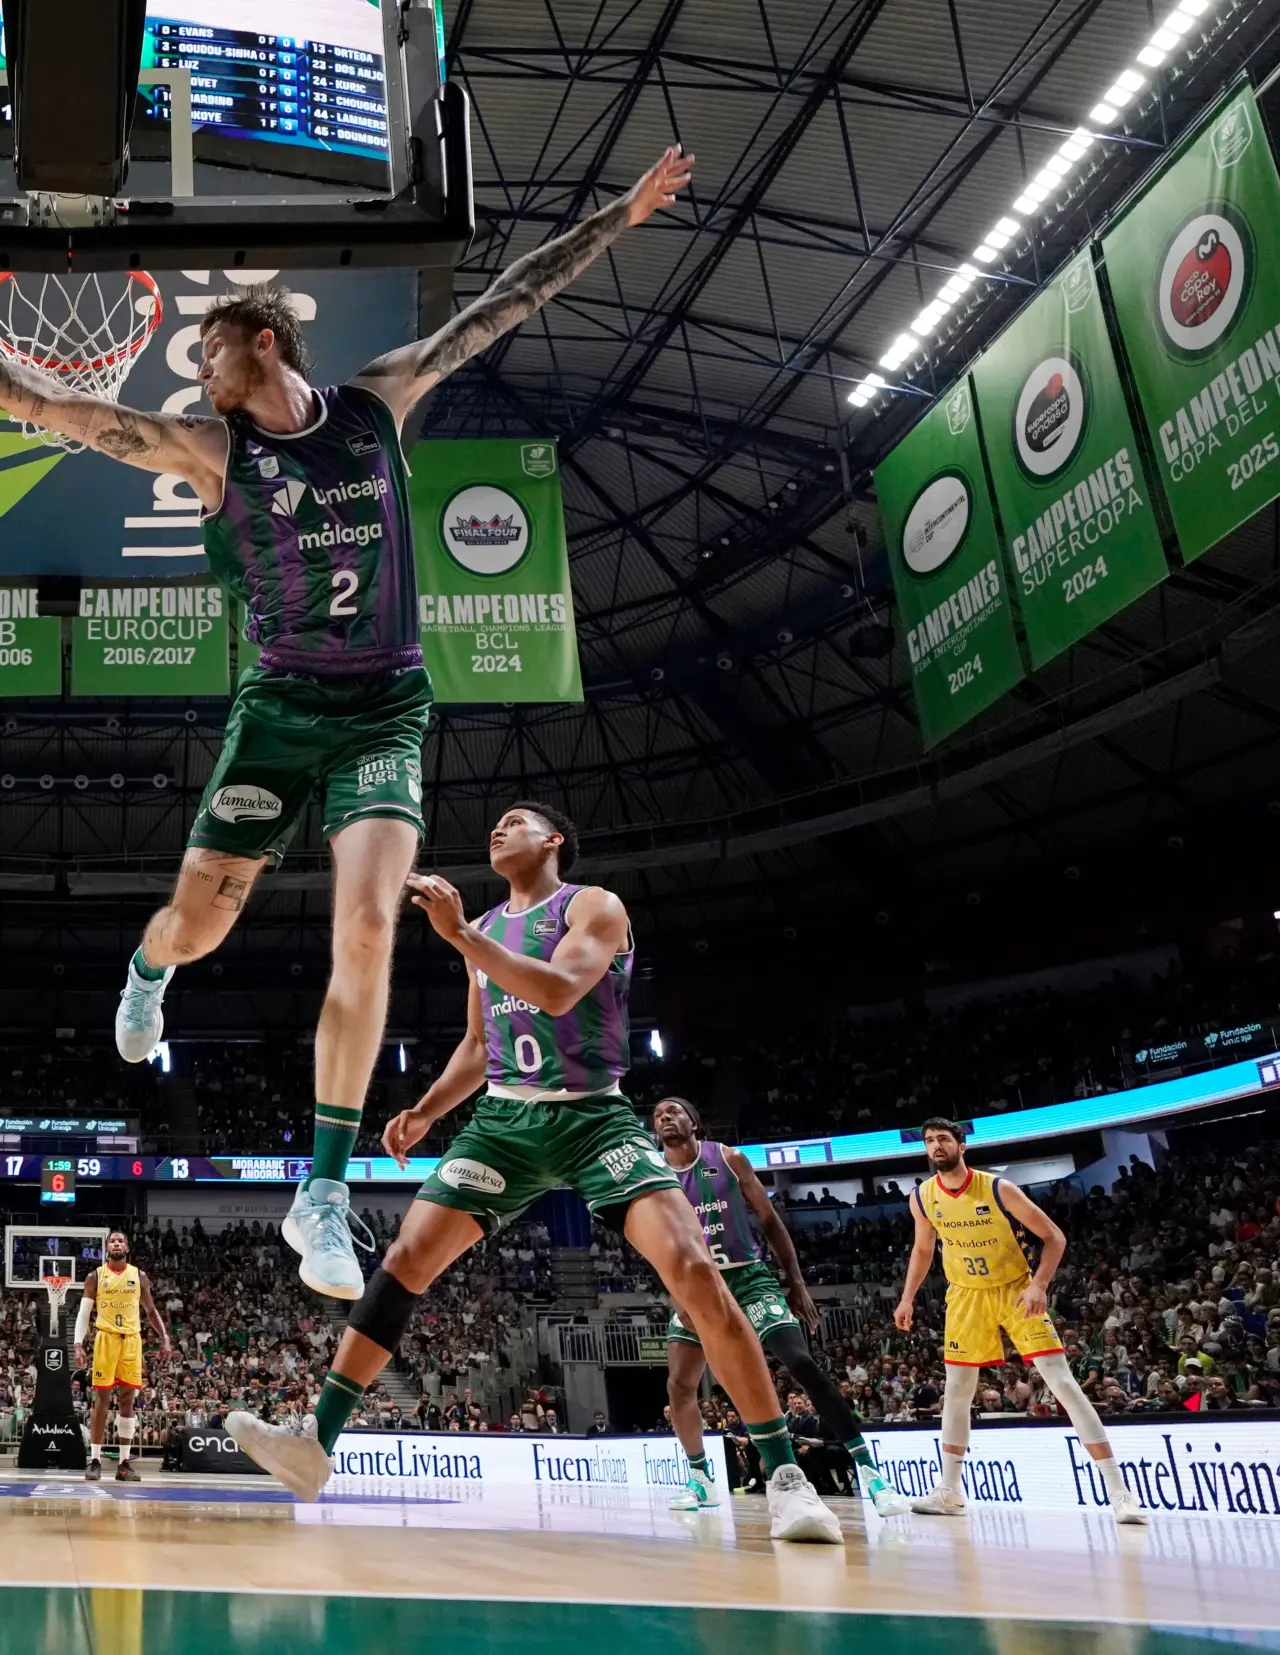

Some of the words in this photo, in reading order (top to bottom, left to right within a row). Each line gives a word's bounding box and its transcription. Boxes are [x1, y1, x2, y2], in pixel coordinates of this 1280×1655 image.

[162, 26, 169, 34] 0
[179, 27, 214, 38] EVANS
[162, 42, 169, 51] 3
[179, 44, 257, 60] GOUDOU-SINHA
[312, 44, 325, 53] 13
[334, 48, 373, 62] ORTEGA
[162, 59, 169, 68] 5
[179, 60, 199, 69] LUZ
[312, 60, 326, 70] 23
[335, 64, 355, 75] DOS
[191, 78, 217, 88] OVET
[313, 76, 327, 86] 24
[336, 80, 366, 93] KURIC
[313, 92, 327, 102] 33
[163, 108, 171, 117] 1
[314, 109, 328, 119] 44
[337, 113, 386, 130] LAMMERS
[314, 126, 328, 136] 45
[1181, 271, 1210, 302] Copa
[1196, 278, 1217, 302] Rey
[1027, 394, 1066, 433] supercopa
[1032, 403, 1068, 440] endesa
[1170, 432, 1221, 482] COPA
[1226, 395, 1267, 438] DEL
[1227, 432, 1280, 490] 2025
[312, 474, 388, 505] Unicaja
[1013, 448, 1134, 573] CAMPEONES
[454, 528, 486, 537] FINAL
[488, 528, 517, 537] FOUR
[1021, 488, 1143, 595] SUPERCOPA
[1062, 556, 1108, 604] 2024
[80, 587, 222, 617] CAMPEONES
[330, 570, 359, 616] 2
[421, 594, 566, 624] CAMPEONES
[907, 560, 999, 664] CAMPEONES
[87, 620, 212, 641] EUROCUP
[913, 656, 931, 675] FIBA
[934, 597, 1002, 659] INTERCONTINENTAL
[476, 633, 518, 649] BCL
[953, 640, 967, 656] CUP
[104, 647, 195, 664] 2016/2017
[472, 655, 522, 672] 2024
[948, 654, 983, 694] 2024
[213, 786, 279, 812] famadesa
[1220, 1023, 1261, 1039] Fundación
[515, 1035, 542, 1073] 0
[1150, 1041, 1187, 1054] Fundación
[6, 1156, 23, 1176] 17
[48, 1161, 71, 1170] 1:59
[78, 1159, 100, 1175] 59
[132, 1161, 142, 1175] 6
[171, 1159, 189, 1178] 13
[232, 1160, 284, 1169] MORABANC
[241, 1170, 285, 1179] ANDORRA
[446, 1162, 503, 1189] famadesa
[52, 1174, 65, 1192] 6
[694, 1199, 728, 1214] nicaja
[944, 1218, 993, 1228] MORABANC
[956, 1238, 998, 1248] Andorra
[709, 1244, 729, 1264] 5
[964, 1257, 989, 1276] 33
[32, 1423, 74, 1435] Andalucía
[333, 1441, 482, 1479] uenteLiviana
[532, 1443, 628, 1484] FuenteLiviana
[1064, 1434, 1280, 1517] FunteLivian
